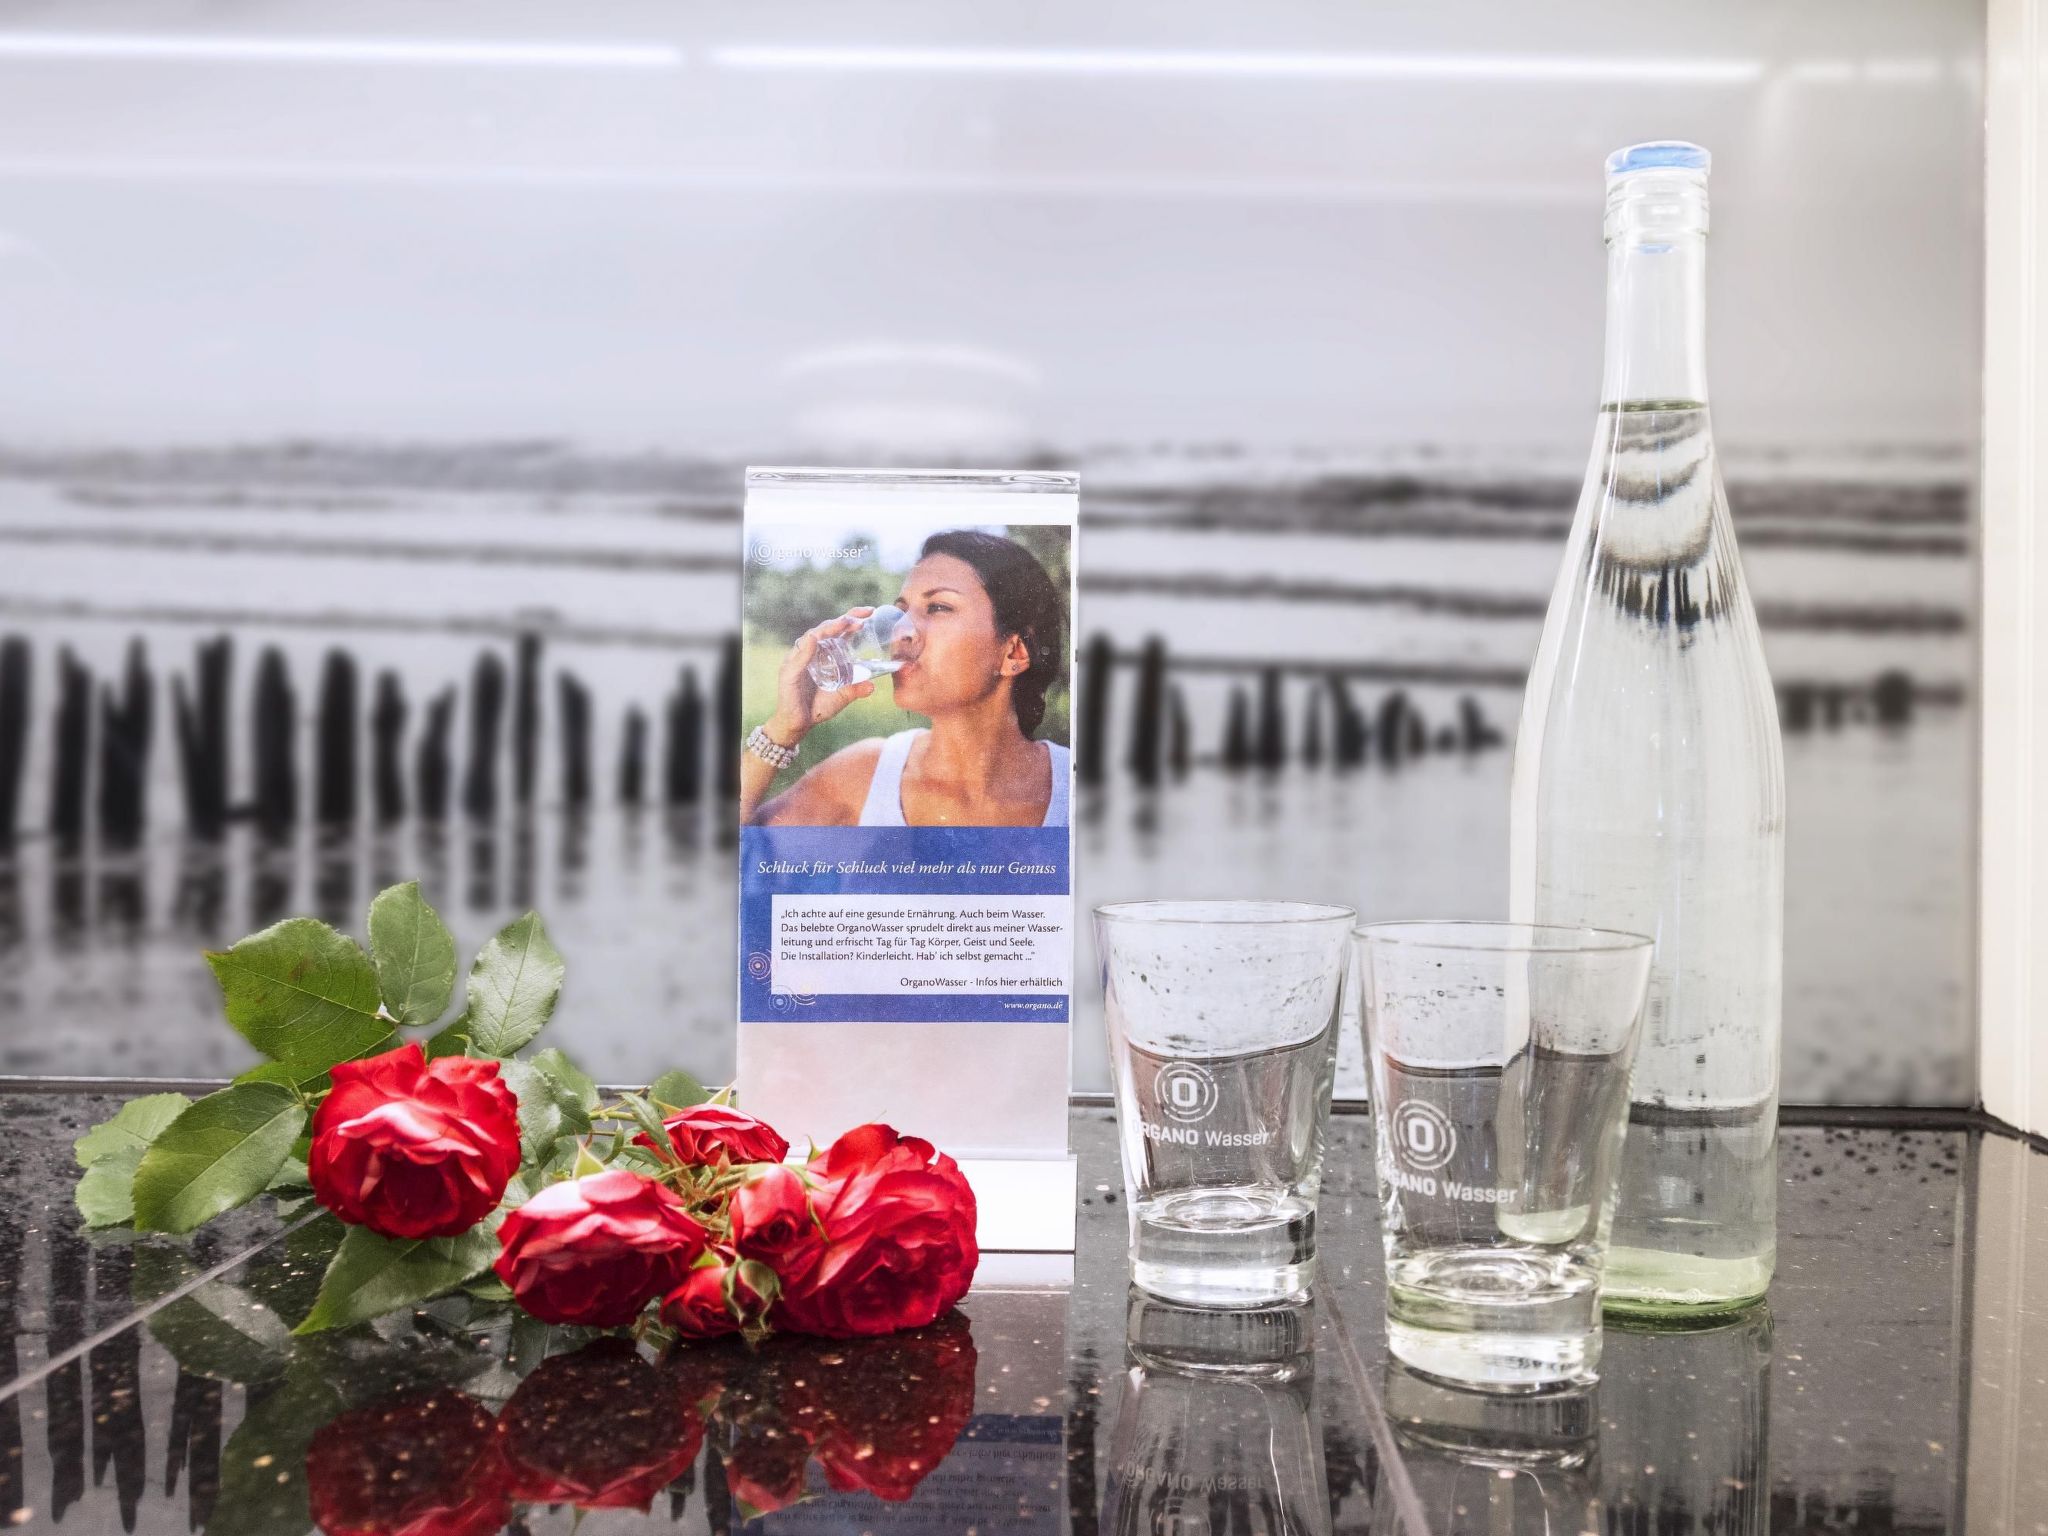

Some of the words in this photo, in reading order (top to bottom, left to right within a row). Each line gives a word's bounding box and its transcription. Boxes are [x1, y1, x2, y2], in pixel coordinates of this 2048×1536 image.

[758, 861, 809, 874] Schluck
[811, 860, 833, 876] für
[836, 860, 887, 874] Schluck
[892, 861, 915, 873] viel
[920, 861, 954, 874] mehr
[958, 861, 976, 874] als
[980, 864, 1004, 874] nur
[1008, 861, 1056, 874] Genuss
[801, 909, 826, 918] achte
[828, 909, 843, 918] auf
[846, 910, 864, 918] eine
[866, 909, 904, 920] gesunde
[908, 910, 957, 920] Ernährung.
[960, 909, 984, 918] Auch
[987, 909, 1009, 918] beim
[1012, 910, 1045, 918] Wasser.
[782, 924, 798, 932] Das
[801, 923, 834, 932] belebte
[837, 923, 903, 934] OrganoWasser
[906, 923, 944, 934] sprudelt
[947, 923, 973, 932] direkt
[993, 924, 1025, 932] meiner
[1028, 924, 1063, 932] Wasser-
[781, 937, 812, 948] leitung
[815, 937, 833, 946] und
[836, 937, 873, 946] erfrischt
[877, 937, 891, 948] Tag
[894, 937, 907, 946] für
[910, 937, 925, 948] Tag
[928, 938, 960, 948] Körper,
[964, 937, 987, 946] Geist
[989, 937, 1007, 946] und
[781, 952, 796, 960] Die
[799, 951, 853, 960] Installation?
[856, 951, 913, 960] Kinderleicht.
[940, 951, 953, 960] ich
[956, 951, 981, 960] selbst
[984, 952, 1023, 963] gemacht
[901, 978, 967, 988] OrganoWasser
[976, 977, 997, 986] Infos
[1000, 977, 1017, 986] hier
[1020, 977, 1062, 986] erhältlich
[1004, 1000, 1063, 1011] www.organo.de
[1205, 1130, 1269, 1147] Wasser
[1442, 1180, 1518, 1204] Wasser
